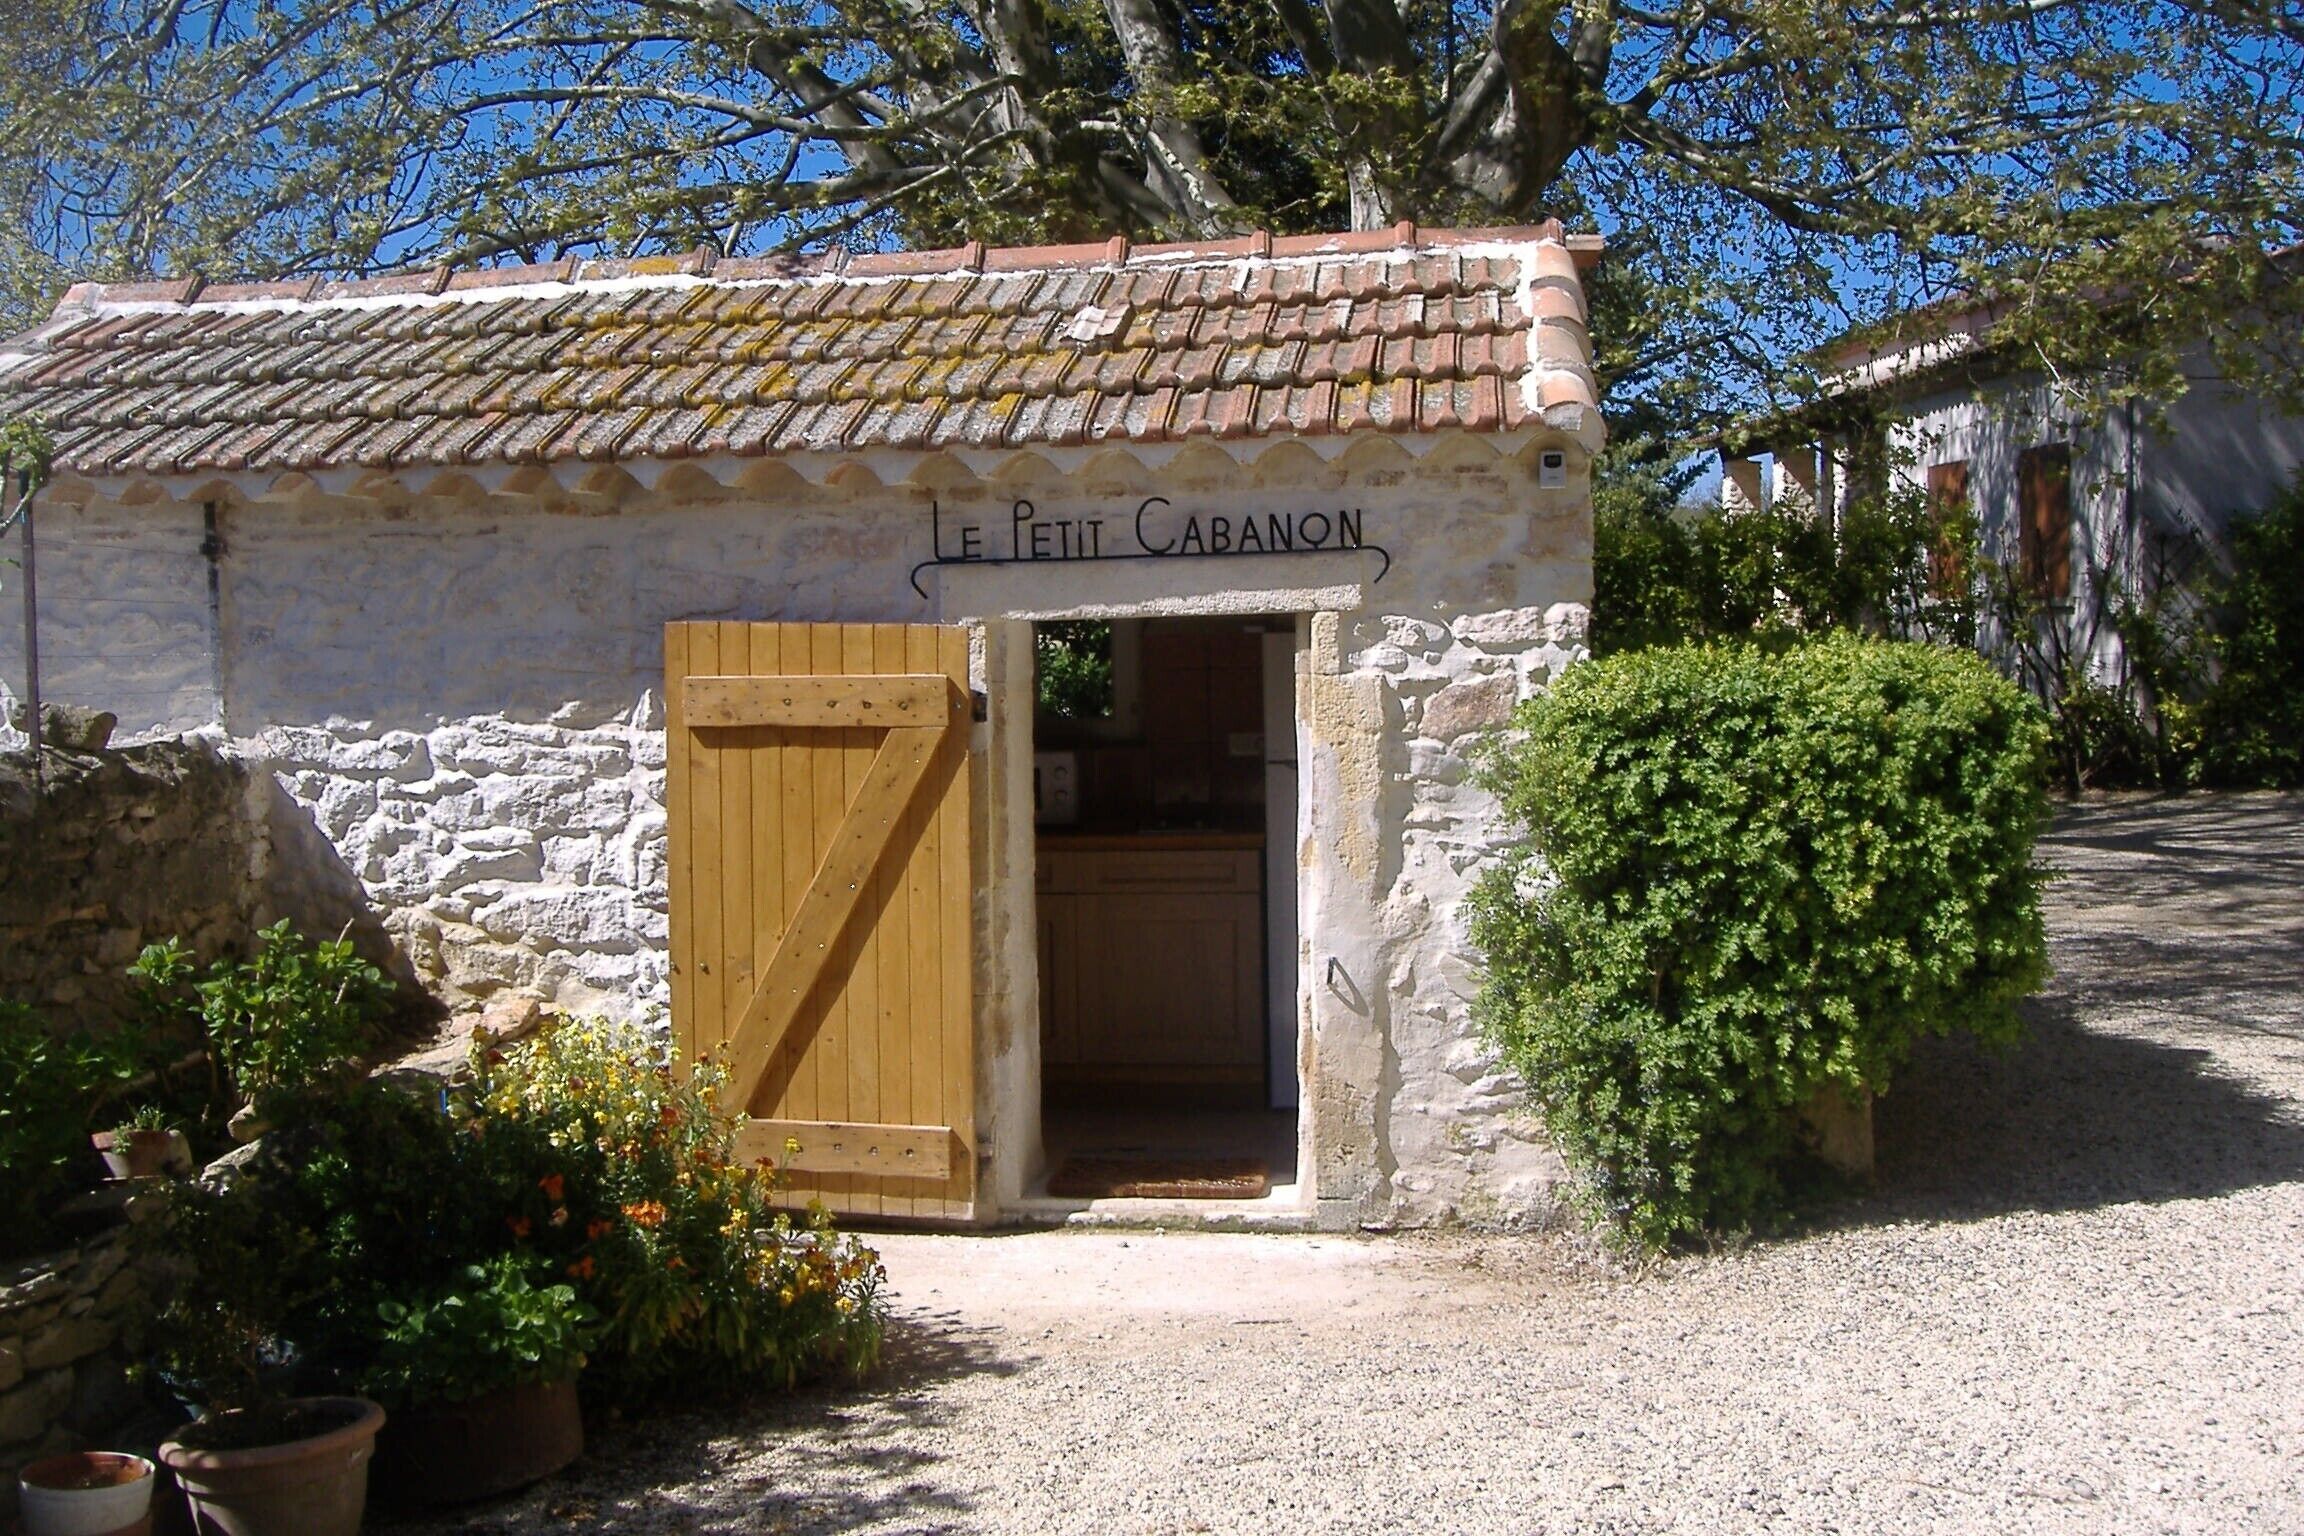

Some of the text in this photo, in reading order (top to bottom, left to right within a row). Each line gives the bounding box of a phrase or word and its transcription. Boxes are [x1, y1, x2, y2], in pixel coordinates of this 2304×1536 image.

[932, 497, 1362, 560] LE PETIT CABANON
